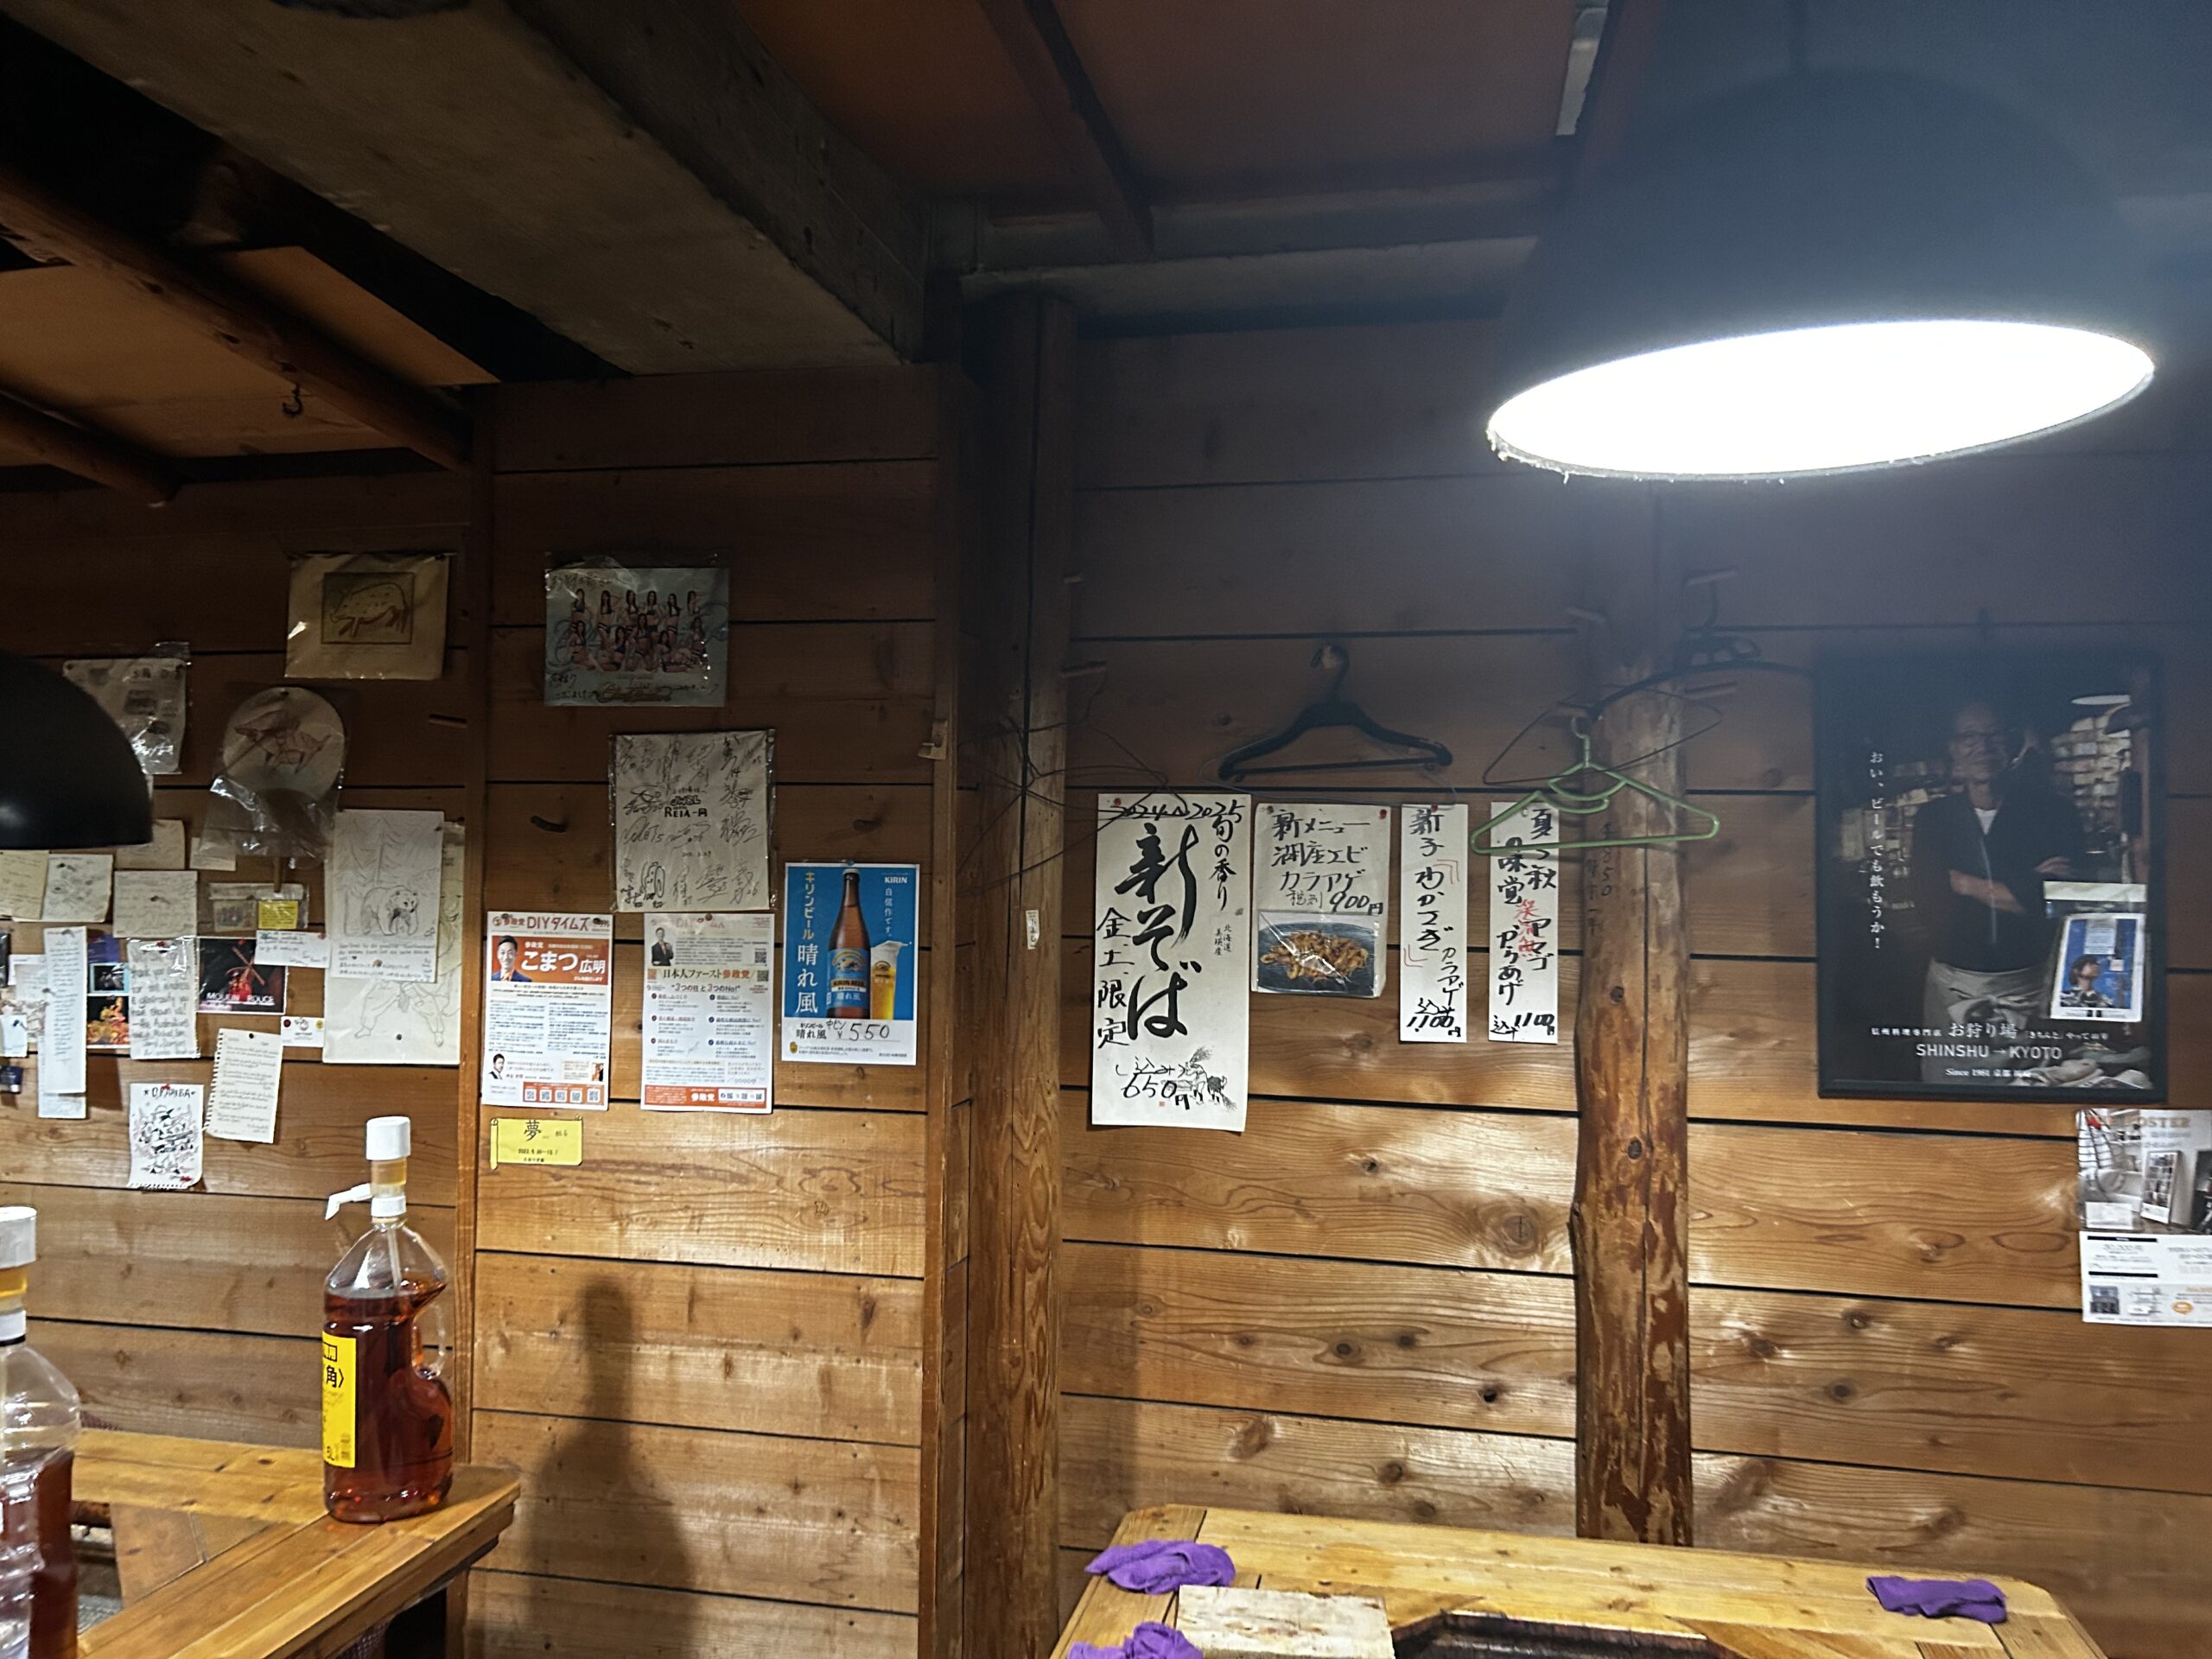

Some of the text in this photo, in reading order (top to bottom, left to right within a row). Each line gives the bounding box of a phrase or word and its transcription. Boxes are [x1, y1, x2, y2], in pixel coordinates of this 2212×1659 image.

[1272, 809, 1370, 841] 新メニュー
[1409, 809, 1445, 857] 新子
[1280, 868, 1366, 893] カラアゲ
[1329, 891, 1384, 916] 900円
[795, 871, 819, 1014] キリンビール 晴れ風
[1114, 822, 1202, 1040] 新そば
[521, 950, 578, 972] こまつ
[796, 1029, 827, 1040] 晴れ風
[849, 1023, 890, 1042] 550
[1915, 1044, 2063, 1060] SHINSHU KYOTO
[1121, 1073, 1190, 1110] 650円
